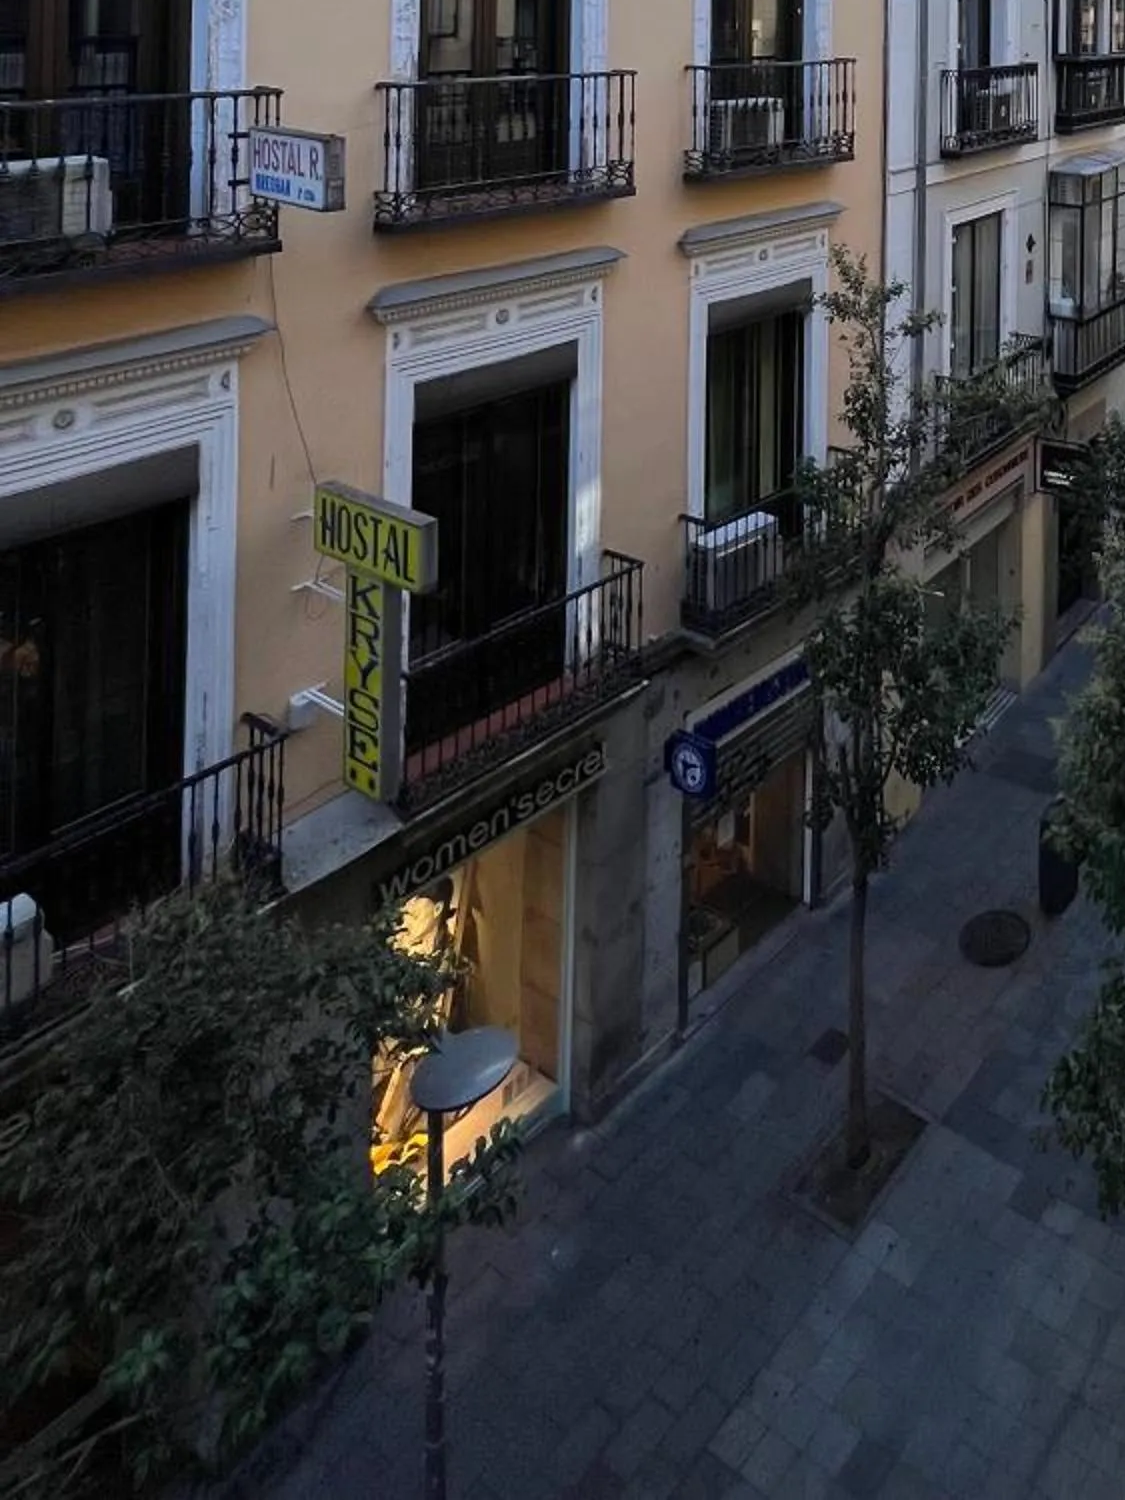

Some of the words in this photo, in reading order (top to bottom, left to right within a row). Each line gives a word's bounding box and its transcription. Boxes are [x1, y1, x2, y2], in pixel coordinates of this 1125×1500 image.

[253, 136, 304, 177] HOSTAL
[321, 497, 416, 583] HOSTAL
[348, 575, 379, 773] KRYSE
